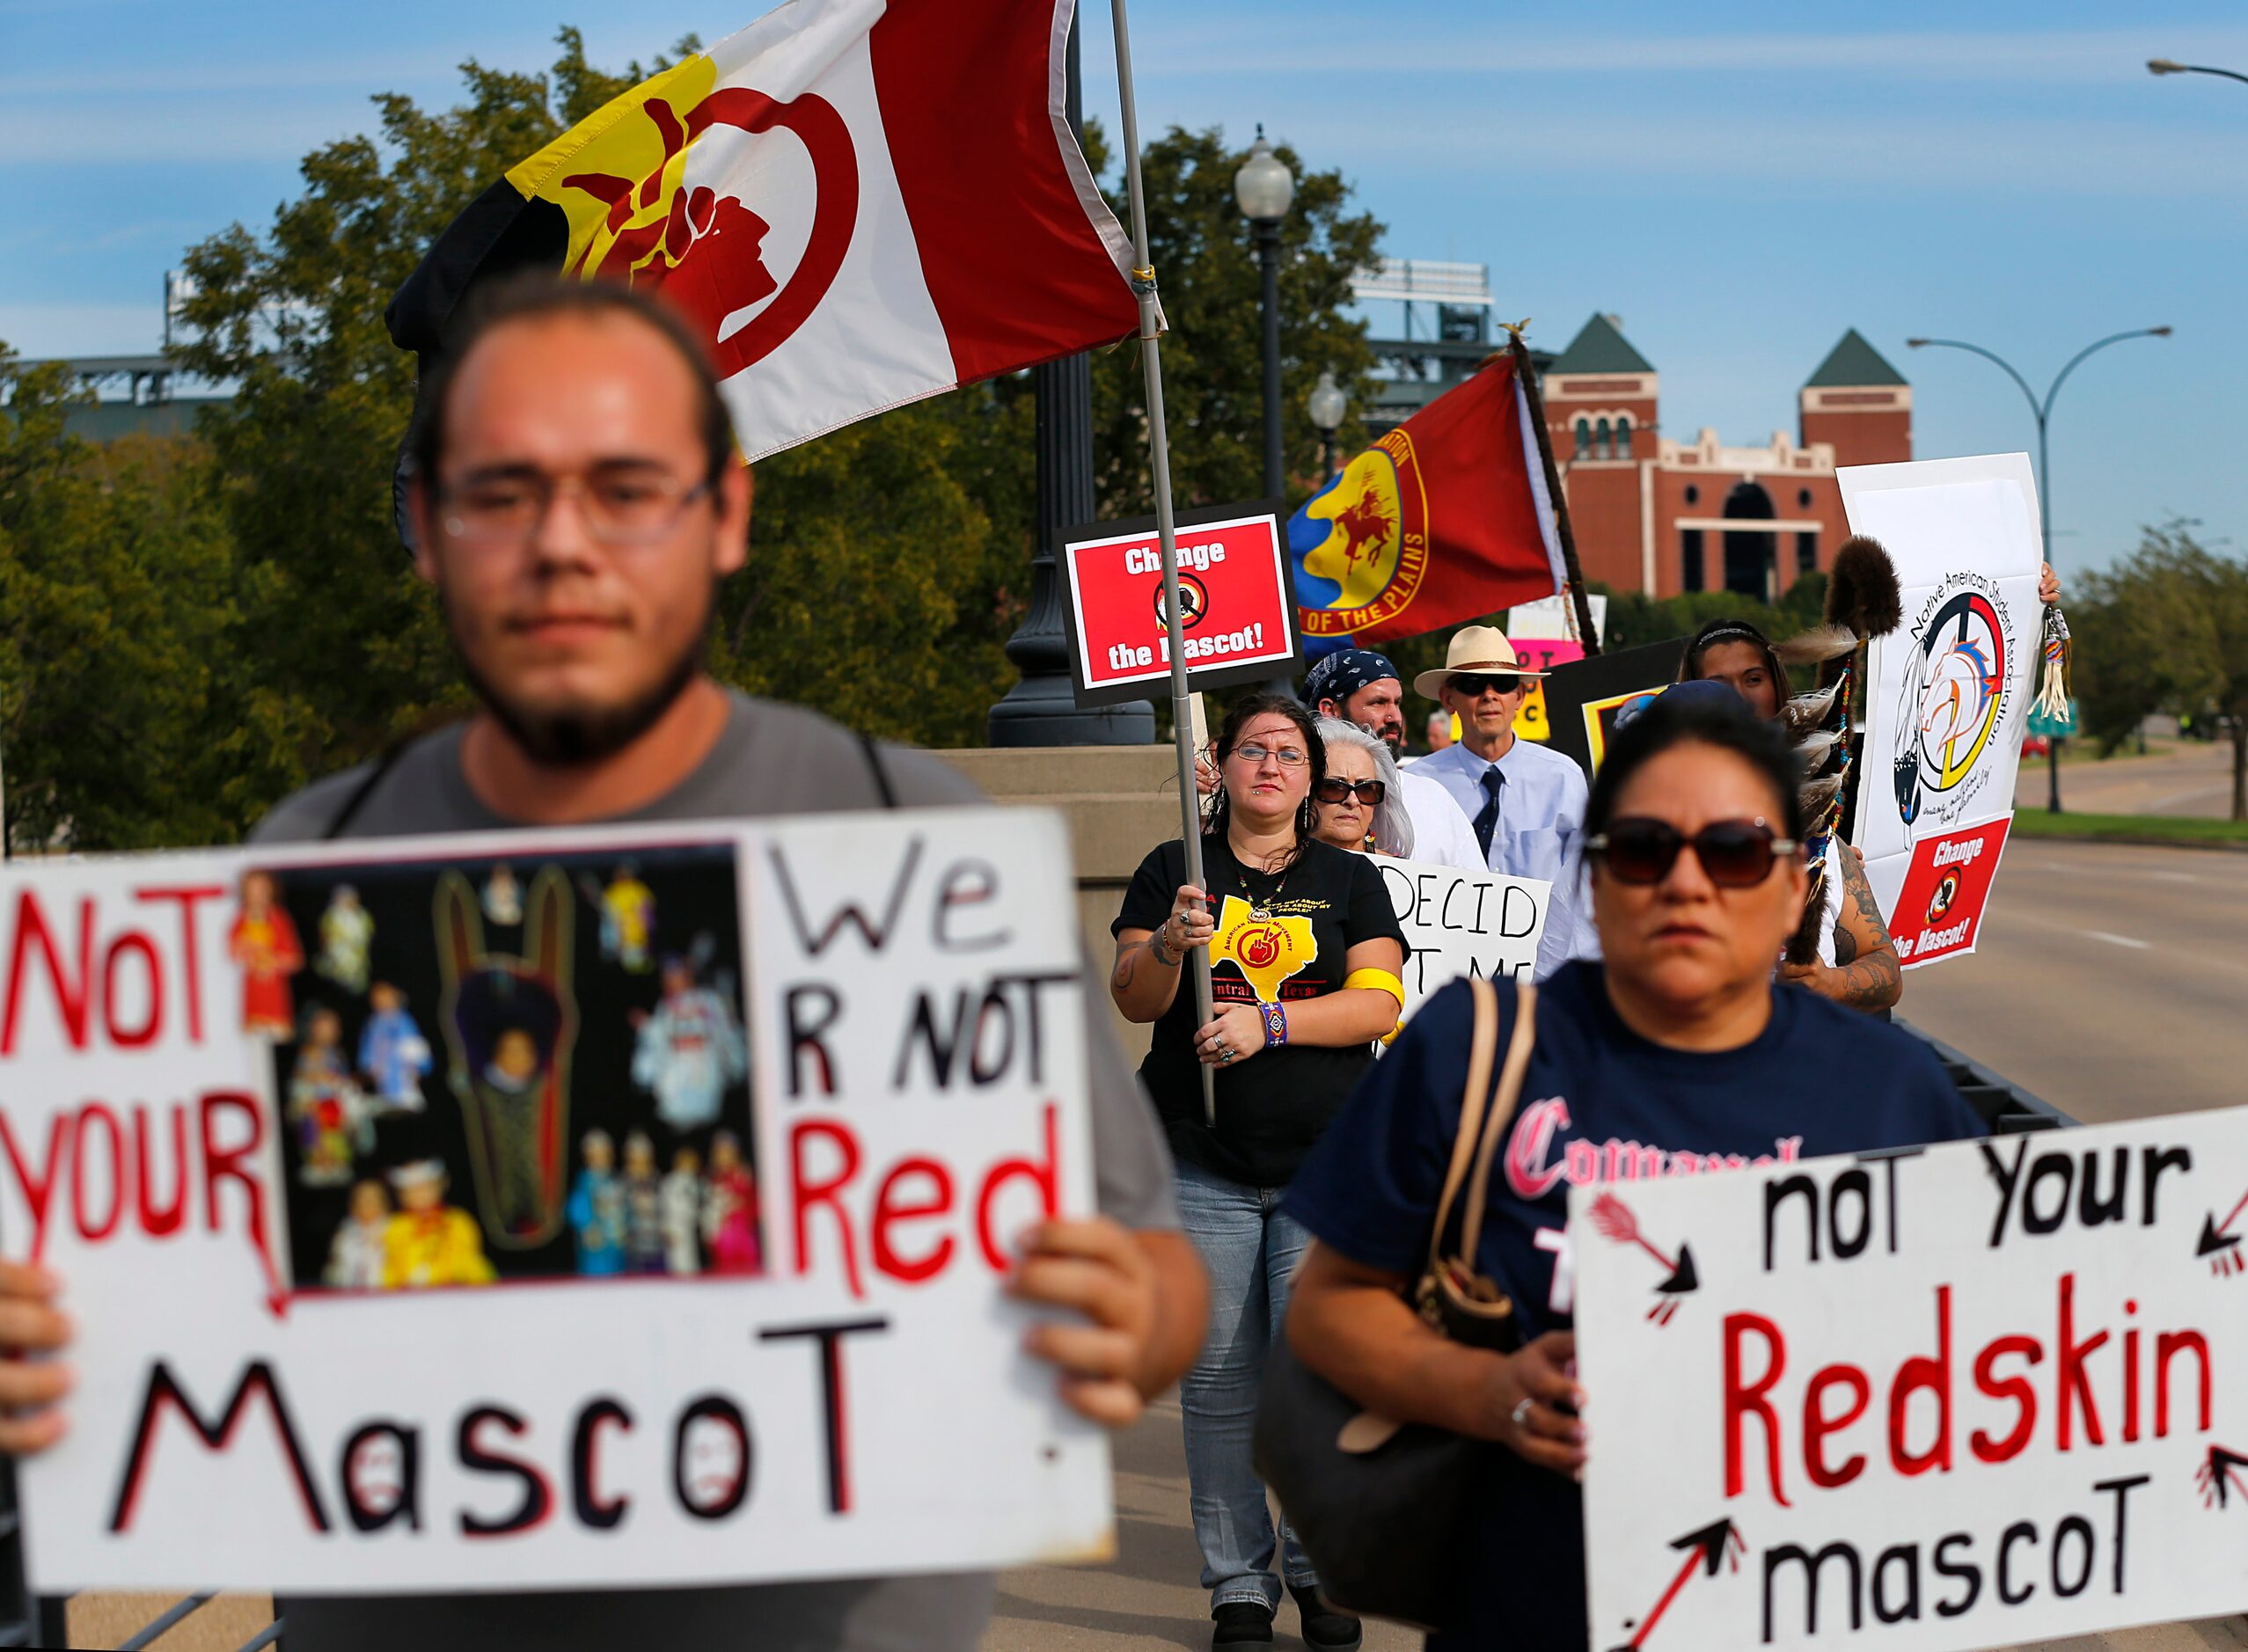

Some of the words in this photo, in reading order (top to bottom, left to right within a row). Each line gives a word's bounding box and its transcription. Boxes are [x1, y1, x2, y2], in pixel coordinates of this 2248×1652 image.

[1124, 542, 1226, 575] Chnge
[1307, 611, 1332, 632] OF
[1338, 603, 1383, 629] THE
[1382, 533, 1424, 610] PLAINS
[1945, 570, 1988, 592] American
[1910, 585, 1945, 640] Native
[1989, 581, 2014, 634] Student
[1108, 642, 1153, 670] the
[1517, 652, 1555, 667] OT
[1988, 638, 2016, 746] Association
[1933, 837, 1984, 867] Change
[765, 831, 1014, 959] We
[1224, 922, 1246, 951] AMERICAN
[1271, 921, 1292, 952] MOVEMENT
[1914, 917, 1971, 956] Mascot!
[1212, 983, 1250, 997] entral
[1282, 983, 1317, 997] Texas
[1411, 948, 1442, 995] T
[786, 983, 840, 1099] R
[890, 971, 1080, 1091] NOT
[0, 1089, 283, 1297] YOUR
[788, 1100, 1059, 1303] Red
[1980, 1136, 2193, 1248] Your
[1723, 1273, 2212, 1508] Redskin
